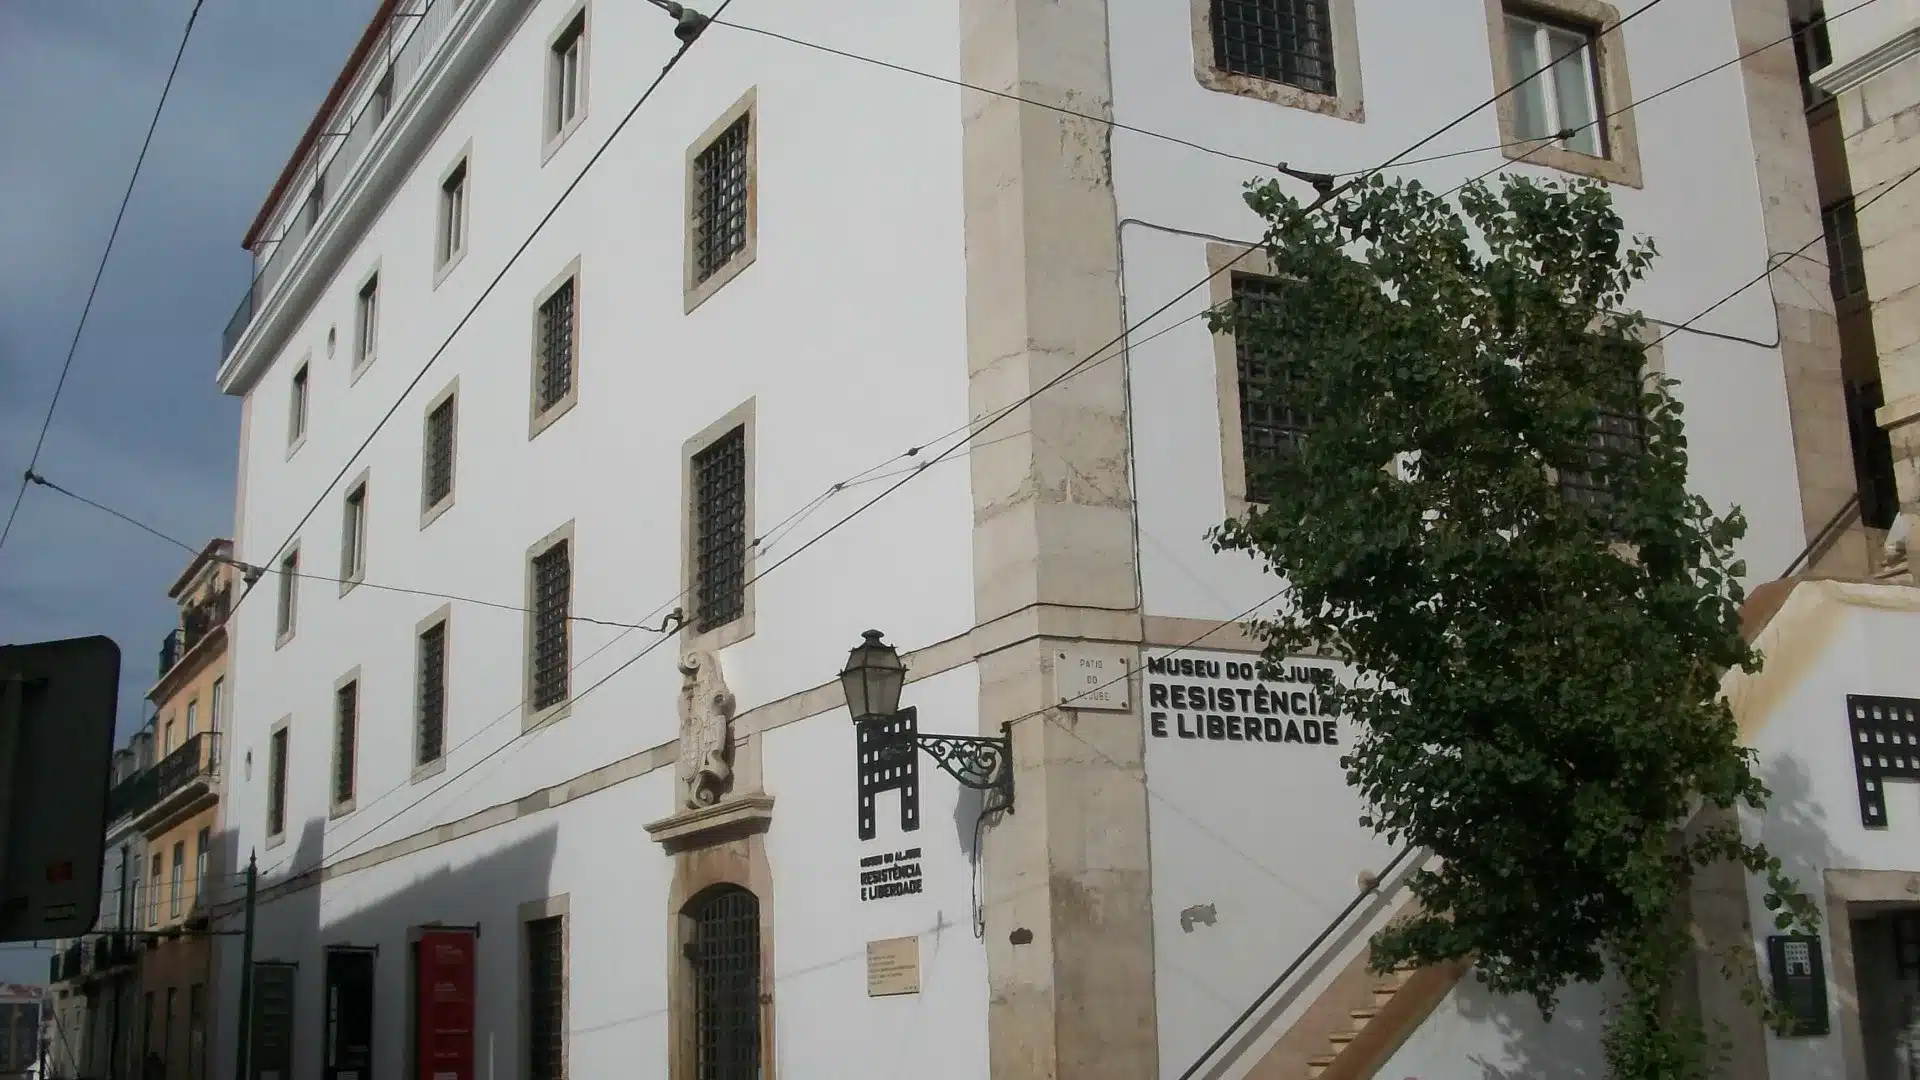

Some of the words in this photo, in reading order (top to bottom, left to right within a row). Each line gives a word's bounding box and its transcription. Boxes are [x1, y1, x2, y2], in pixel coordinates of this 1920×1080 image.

[1148, 656, 1220, 679] MUSEU
[1226, 662, 1253, 681] DO
[1149, 683, 1341, 717] RESISTÊNCIA
[1151, 712, 1168, 738] E
[1177, 713, 1339, 745] LIBERDADE
[861, 887, 867, 901] E
[868, 878, 923, 900] LIBERDADE
